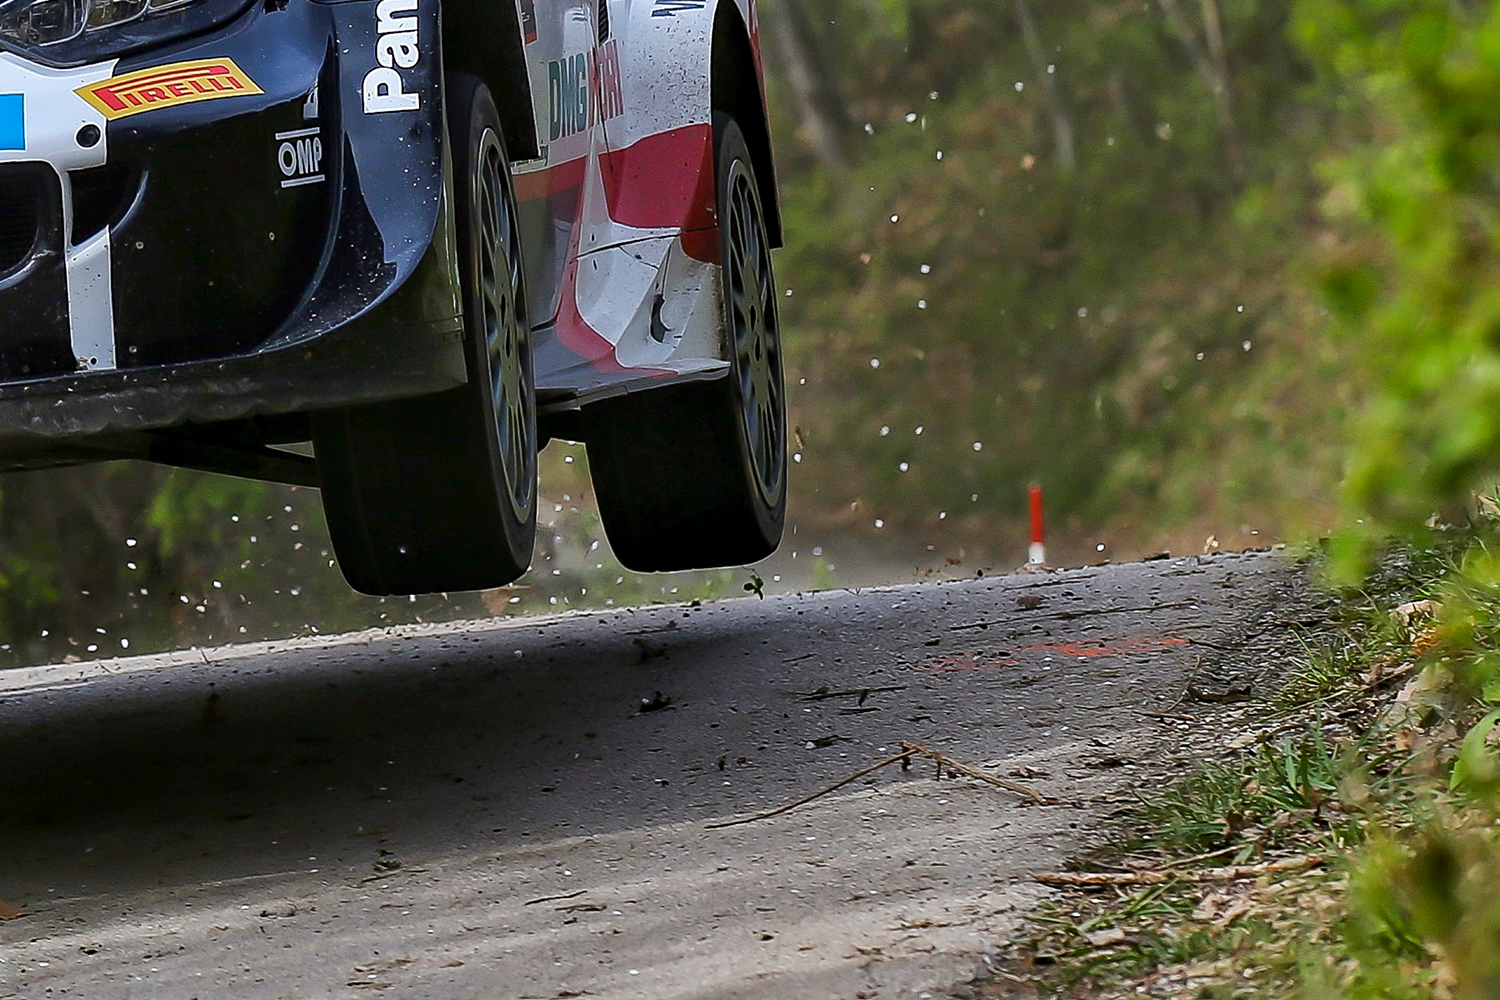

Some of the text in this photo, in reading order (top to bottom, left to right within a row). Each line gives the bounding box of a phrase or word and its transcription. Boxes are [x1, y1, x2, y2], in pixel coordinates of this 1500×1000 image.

[91, 65, 244, 112] PIRELLI
[548, 51, 589, 142] DMG
[277, 136, 323, 177] OMP
